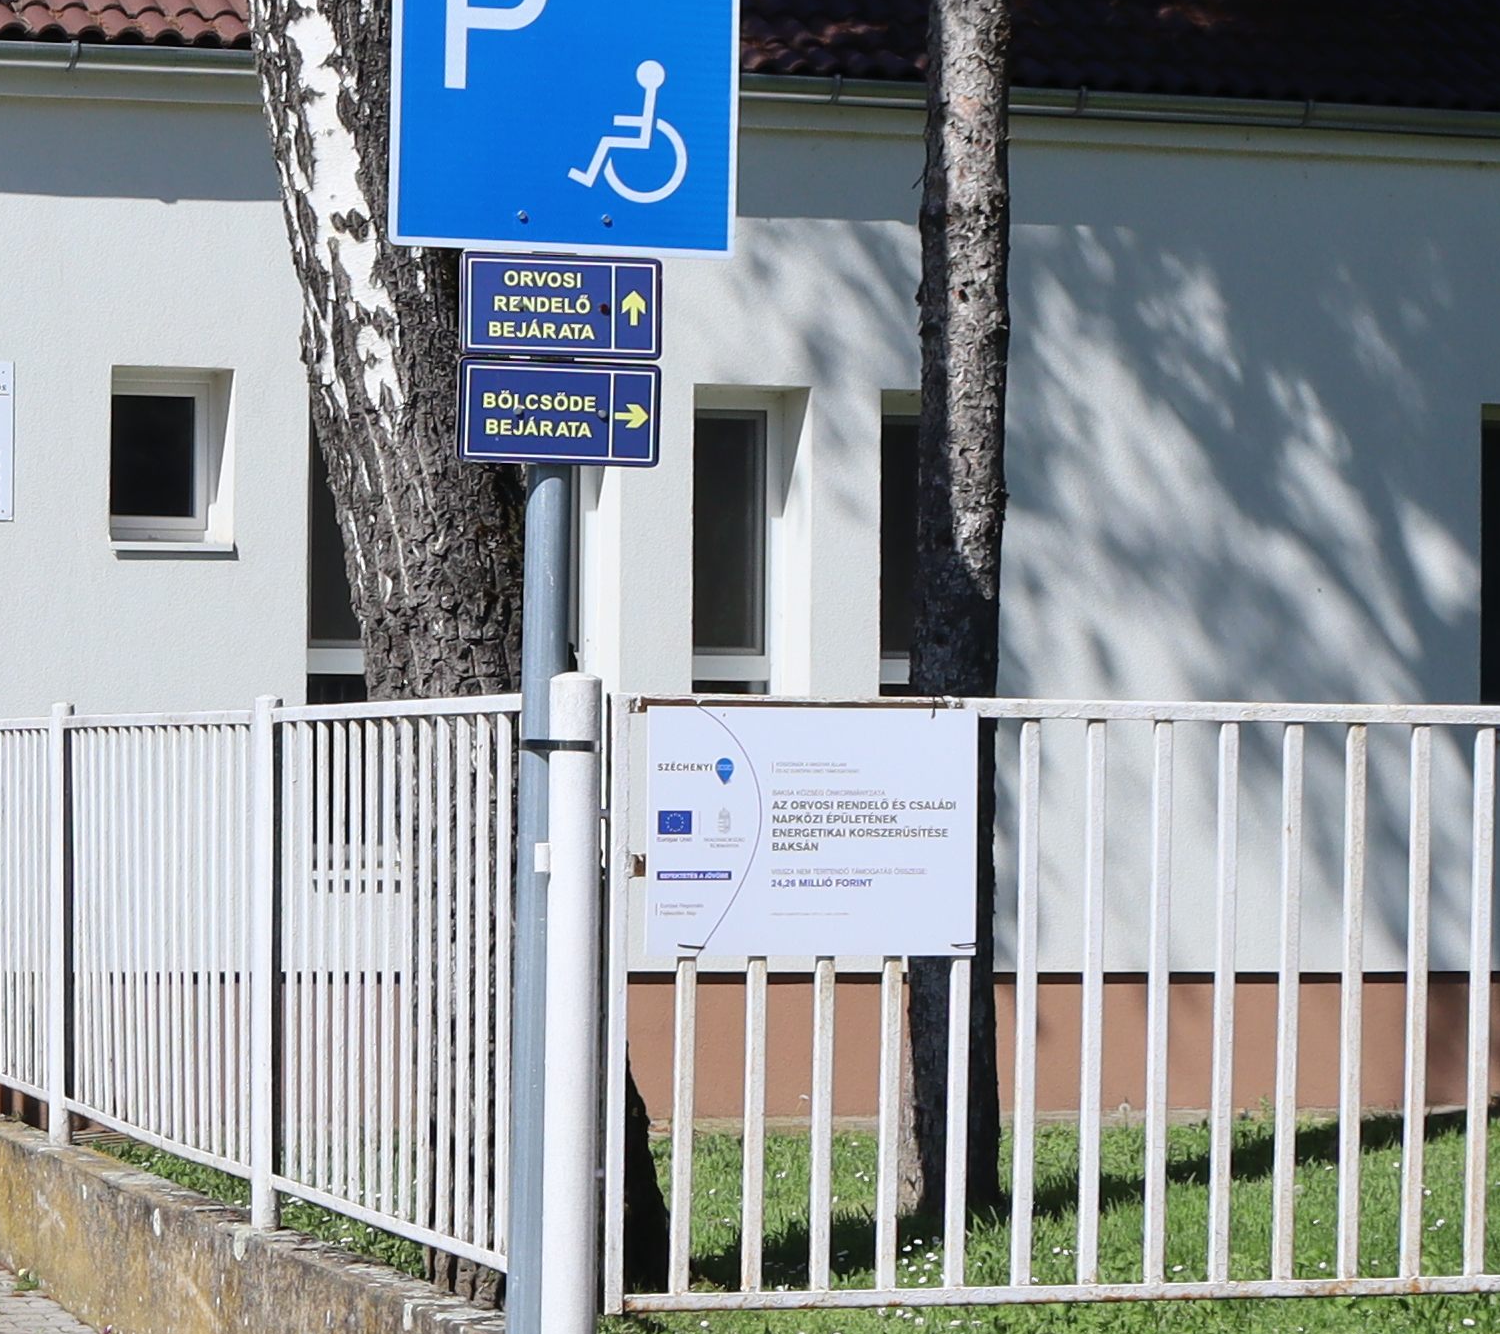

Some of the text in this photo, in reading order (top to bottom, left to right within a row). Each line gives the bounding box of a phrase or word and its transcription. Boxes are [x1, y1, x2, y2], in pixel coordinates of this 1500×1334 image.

[503, 270, 582, 289] ORVOSI
[493, 294, 591, 314] RENDELŐ
[488, 319, 595, 340] BEJÁRATA
[482, 390, 597, 412] BŐLCSŐDE
[485, 416, 592, 438] BEJÁRATA
[657, 761, 713, 771] SZÉCHENYI
[772, 798, 957, 811] AZ ORVOSI RENDELŐ ÉS CSALÁDI
[772, 812, 898, 824] NAPKÖZI ÉPÜLETÉNEK
[772, 825, 949, 838] ENERGETIKAI KORSZERŰSÍTÉSE
[772, 841, 819, 852] BAKSÁN
[798, 877, 833, 887] MILLIÓ
[835, 879, 872, 887] FORINT
